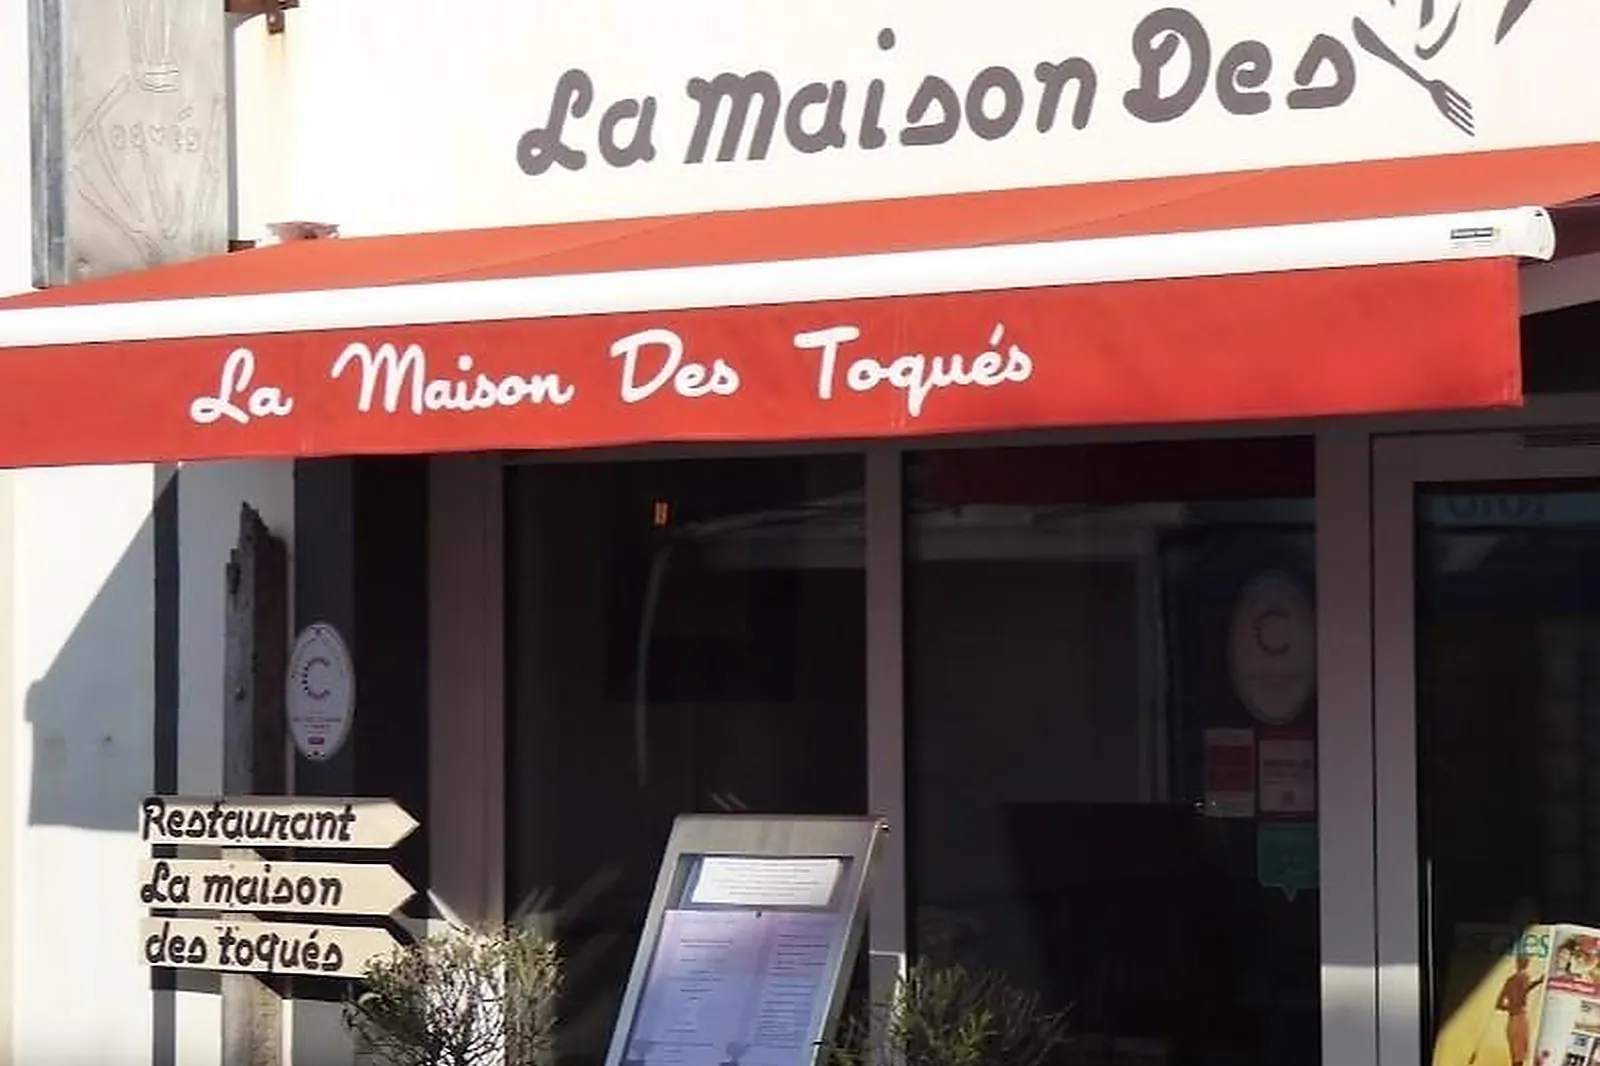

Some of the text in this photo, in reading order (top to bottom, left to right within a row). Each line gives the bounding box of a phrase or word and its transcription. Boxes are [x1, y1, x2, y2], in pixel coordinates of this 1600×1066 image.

[517, 69, 656, 176] La
[1123, 8, 1356, 123] Des
[191, 324, 1032, 423] La Maison Des Toqués
[142, 797, 356, 842] Restaurant
[140, 861, 342, 905] La maison
[146, 921, 343, 972] des toqués
